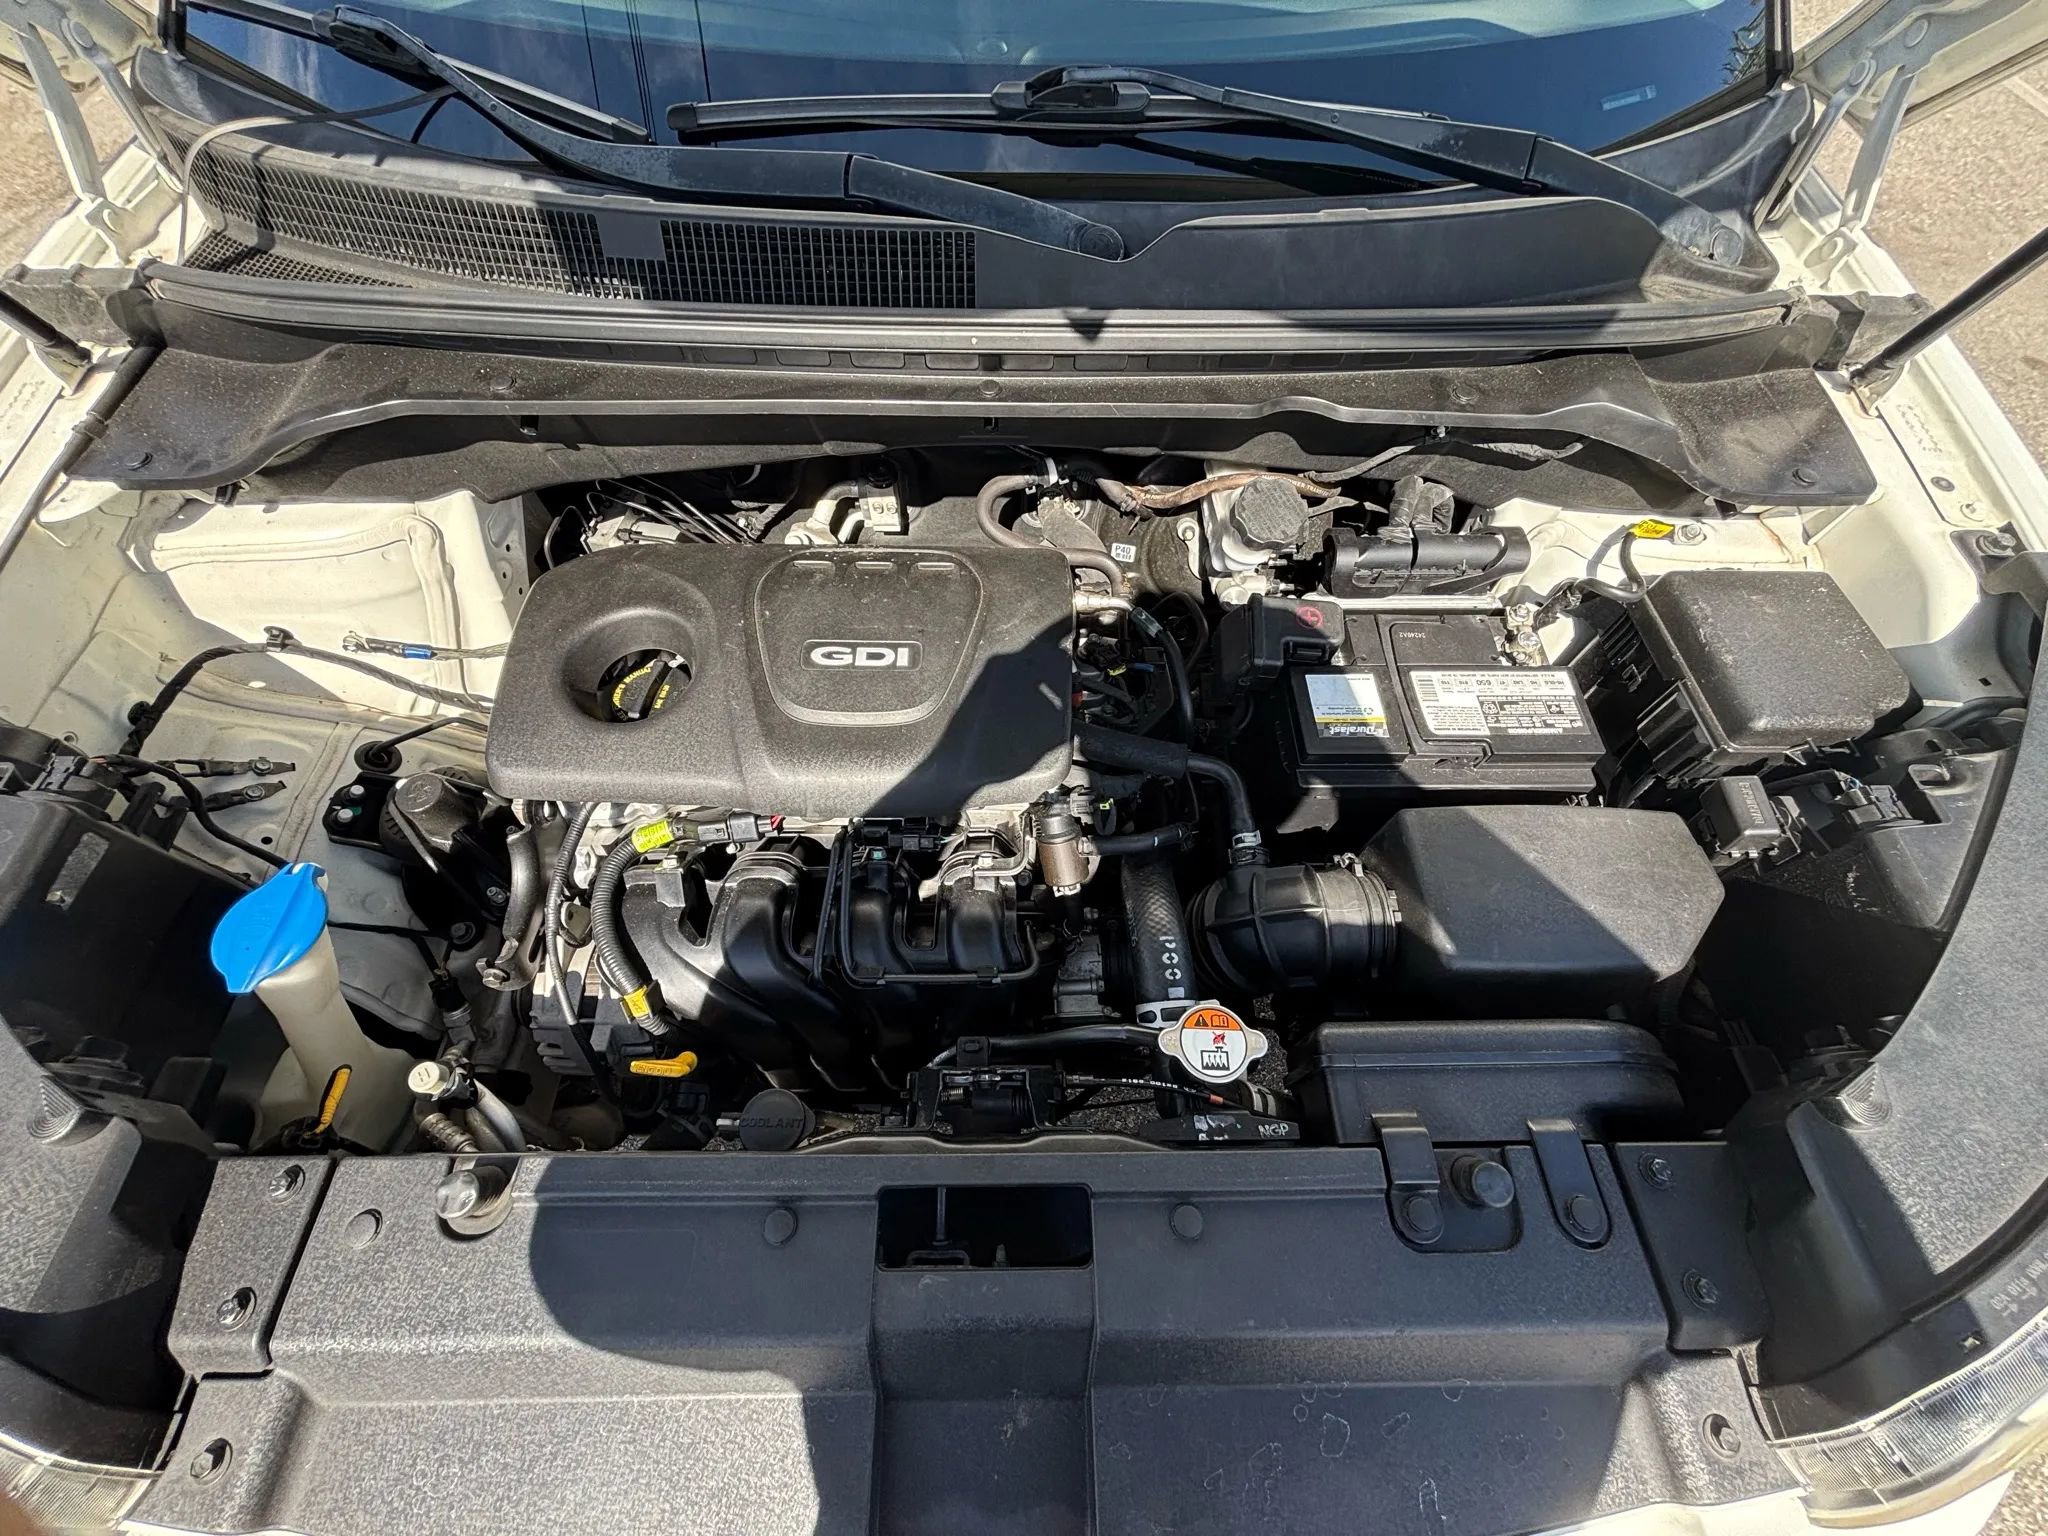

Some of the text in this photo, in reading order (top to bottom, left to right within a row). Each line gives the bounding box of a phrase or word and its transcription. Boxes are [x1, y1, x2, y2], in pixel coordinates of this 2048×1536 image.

[810, 646, 909, 667] GDI
[1328, 725, 1378, 735] Duralast
[741, 1118, 804, 1128] COOLANT
